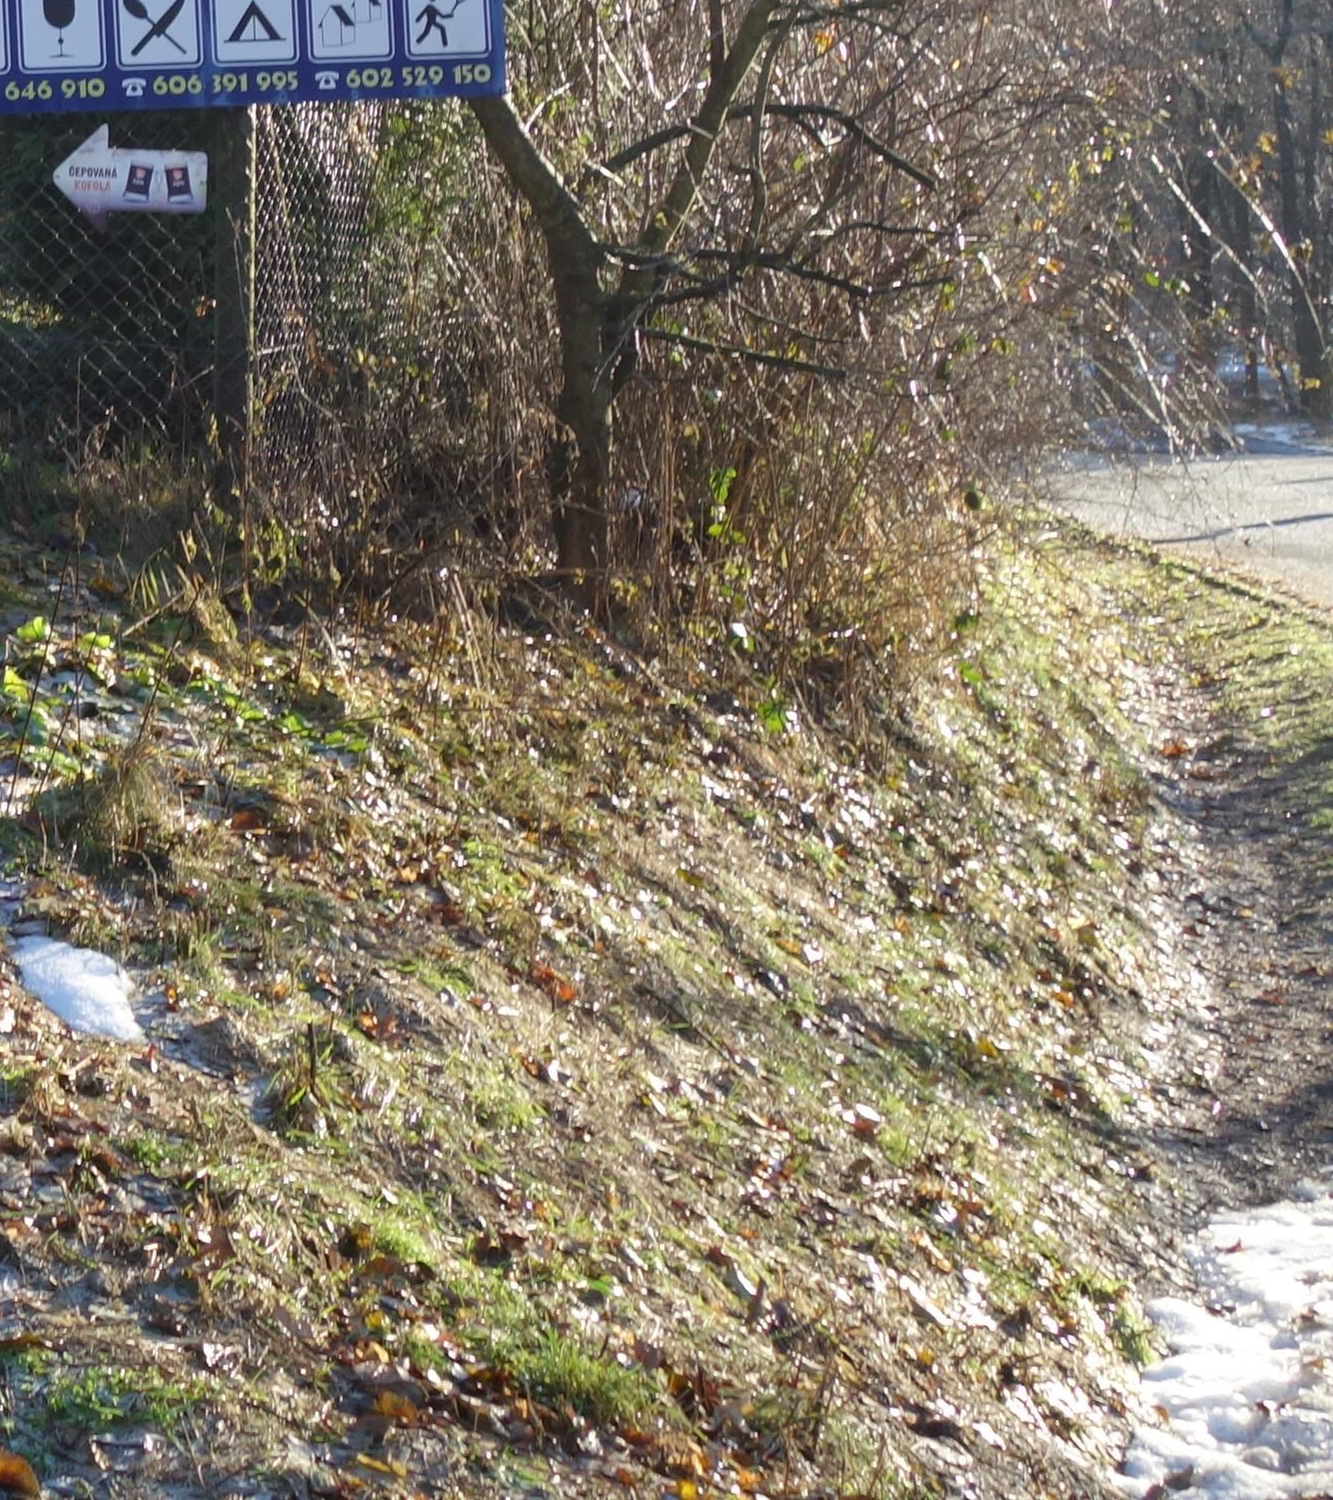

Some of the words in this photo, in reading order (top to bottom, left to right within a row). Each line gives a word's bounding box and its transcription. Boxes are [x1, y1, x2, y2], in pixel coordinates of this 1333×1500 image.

[4, 79, 53, 100] 646
[61, 78, 105, 99] 910
[152, 75, 203, 95] 606
[212, 73, 248, 94] 391
[256, 71, 298, 91] 995
[346, 68, 394, 89] 602
[402, 65, 444, 86] 529
[453, 64, 491, 84] 150
[74, 179, 111, 191] KOFOLA
